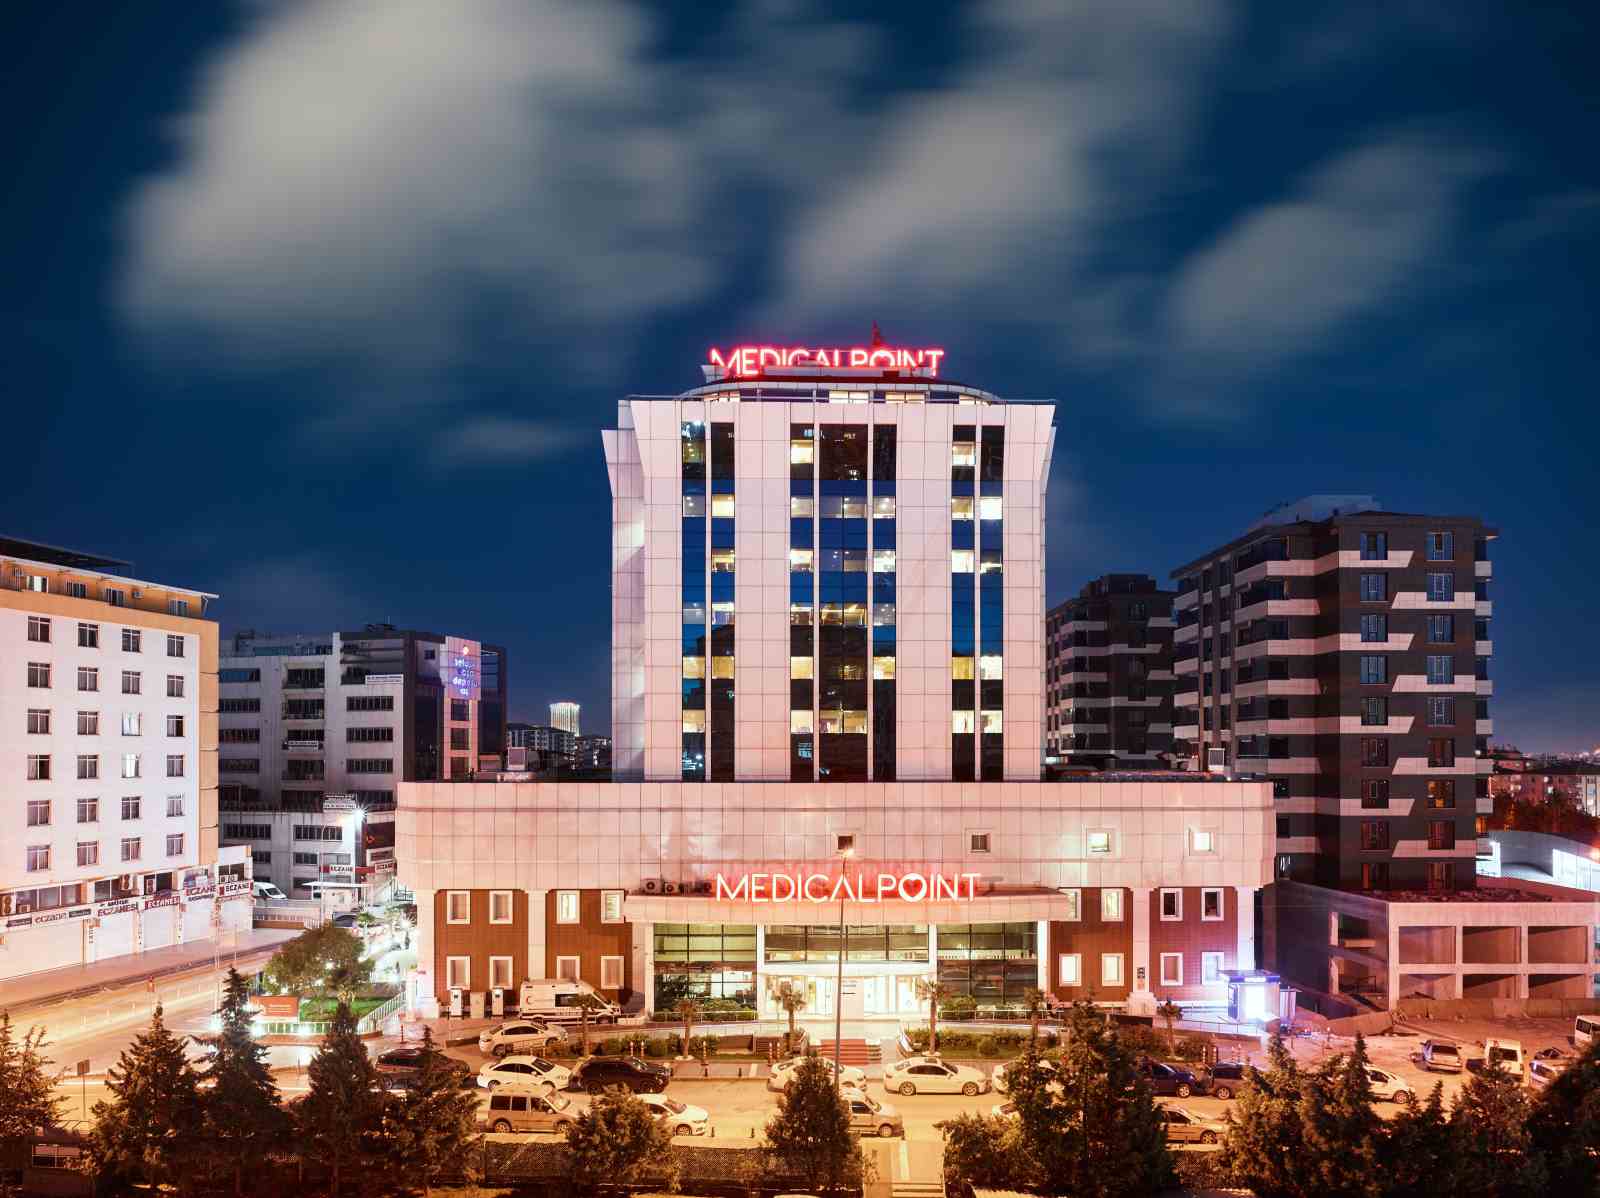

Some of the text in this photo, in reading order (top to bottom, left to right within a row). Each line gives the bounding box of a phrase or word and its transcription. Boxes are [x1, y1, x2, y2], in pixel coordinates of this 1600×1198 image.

[185, 886, 216, 896] ECZANE
[225, 882, 249, 892] ECZANE
[715, 873, 981, 903] MEDICALPOINT
